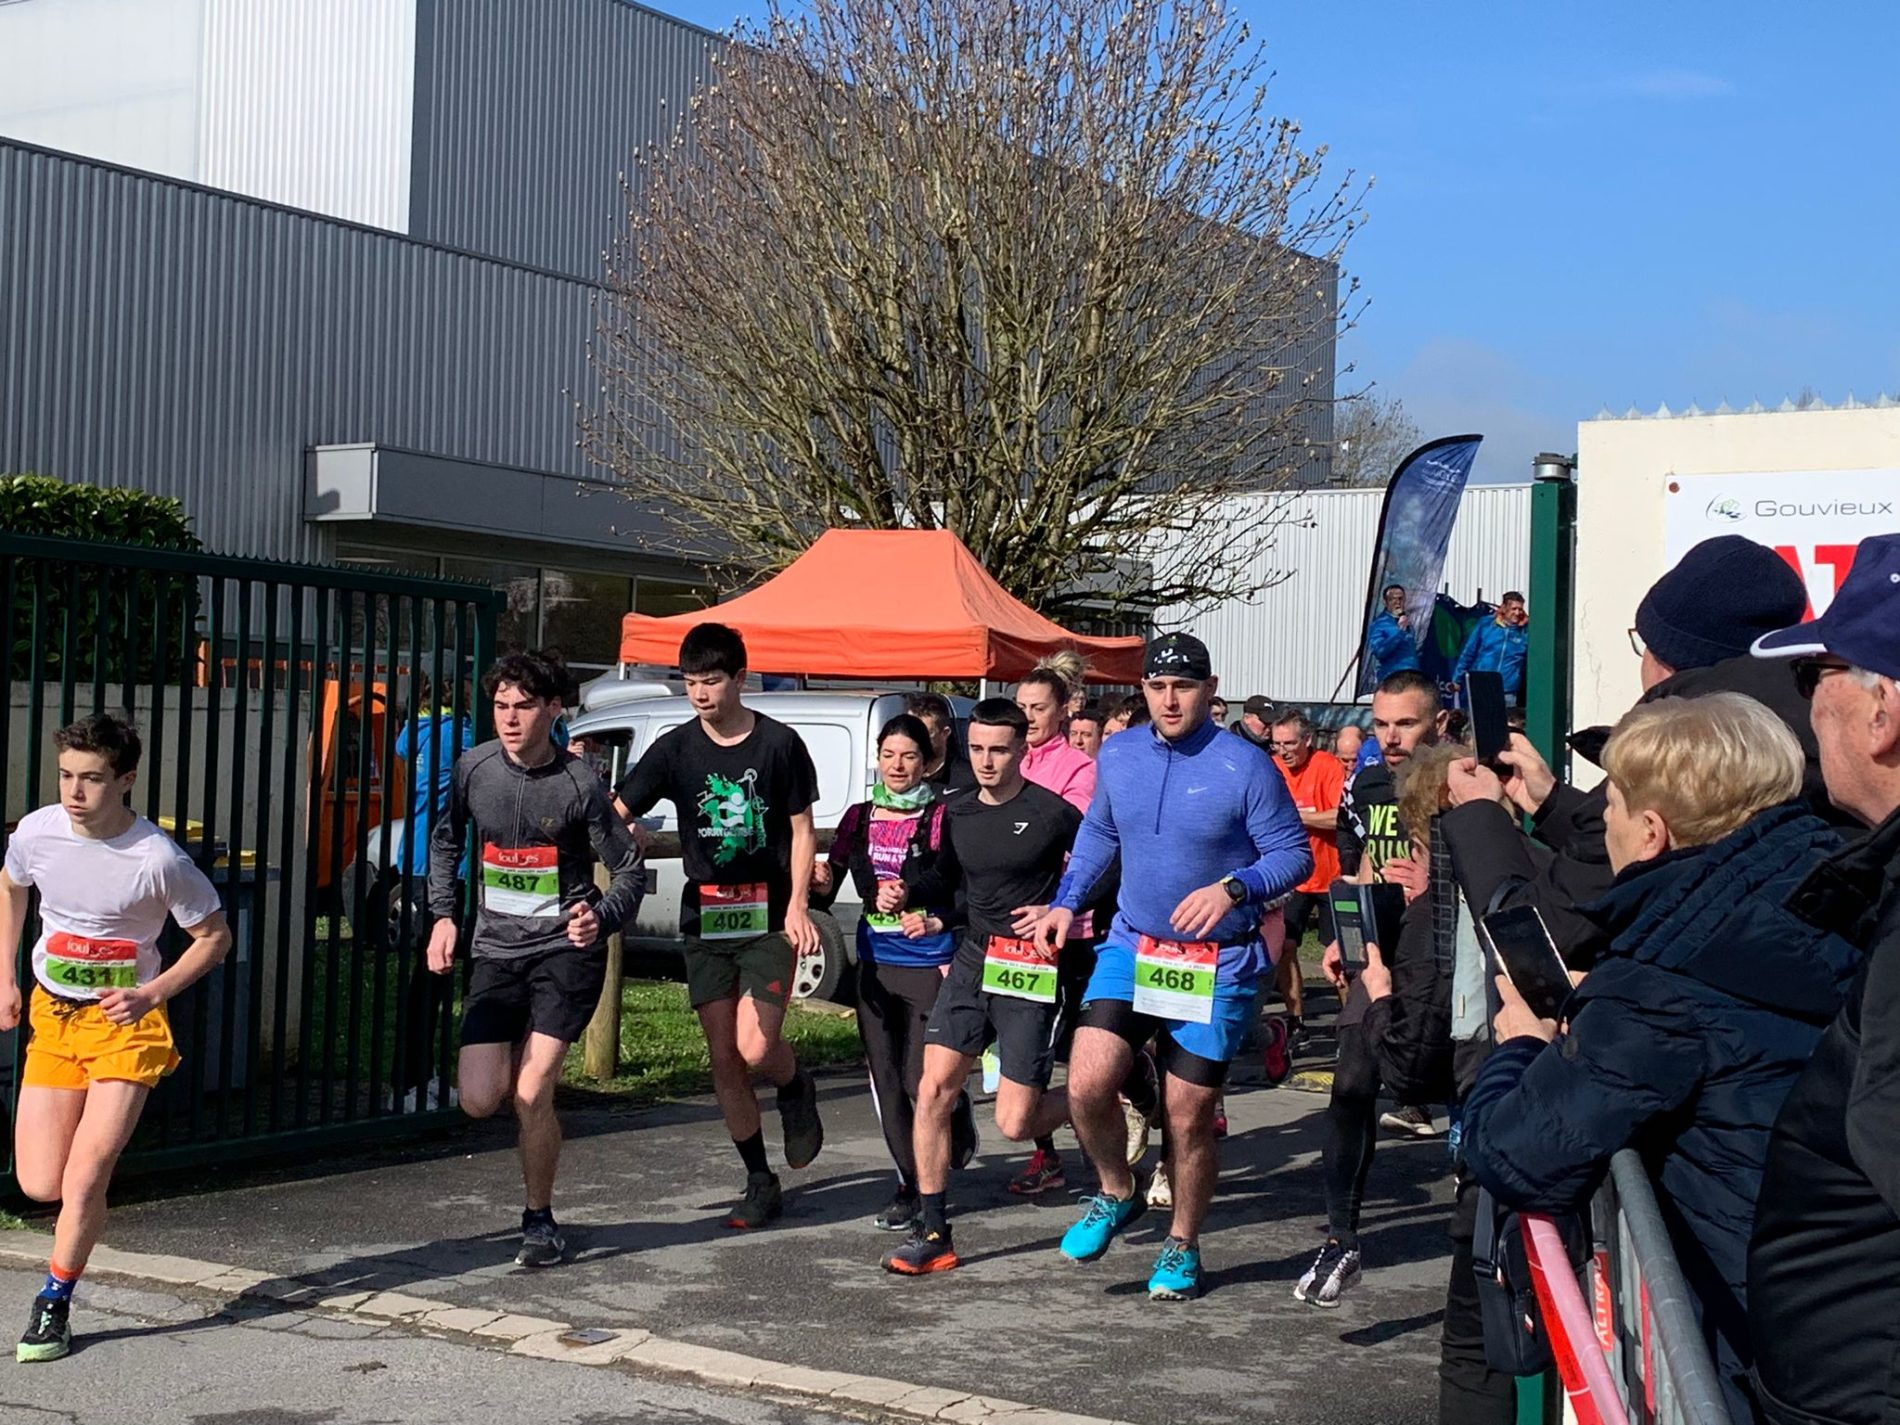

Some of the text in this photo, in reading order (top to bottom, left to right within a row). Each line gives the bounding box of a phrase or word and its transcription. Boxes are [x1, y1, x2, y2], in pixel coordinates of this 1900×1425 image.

[1755, 499, 1893, 517] Gouvieux
[1368, 804, 1399, 837] WE
[1367, 838, 1410, 869] RUN
[498, 873, 540, 891] 487
[713, 910, 752, 931] 402
[62, 966, 112, 985] 431
[996, 969, 1040, 991] 467
[1149, 967, 1195, 991] 468
